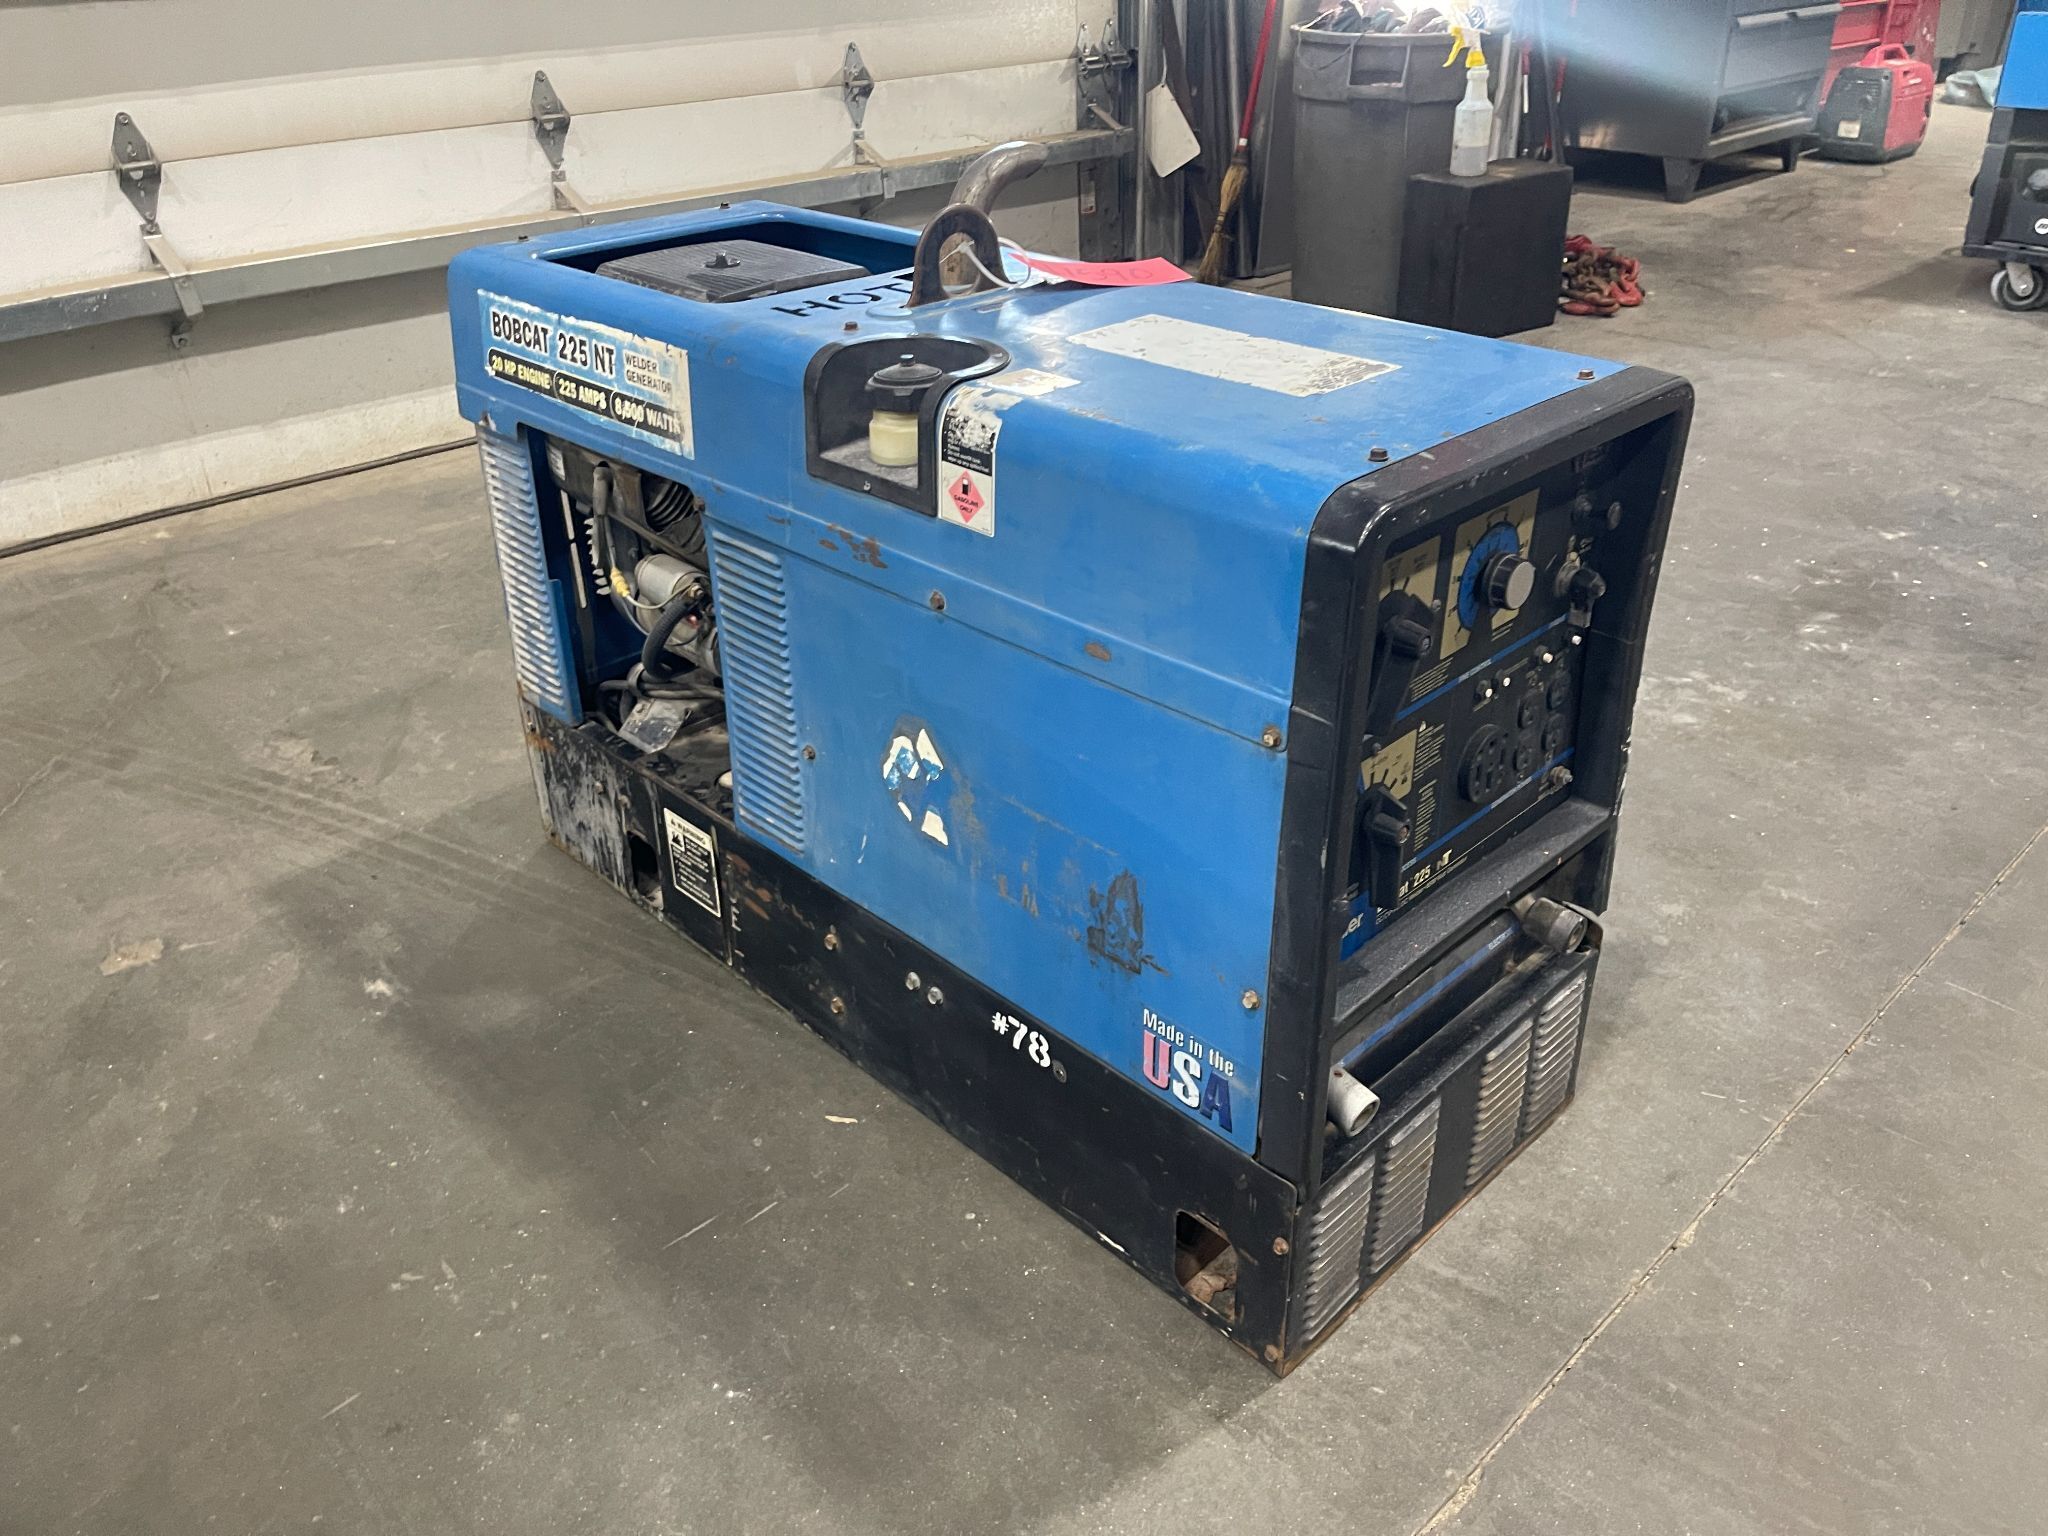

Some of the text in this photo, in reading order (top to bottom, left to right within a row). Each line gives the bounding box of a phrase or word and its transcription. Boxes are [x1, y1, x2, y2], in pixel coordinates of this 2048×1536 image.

[492, 311, 615, 376] BOBCAT 225 NT
[492, 355, 551, 389] 20 HP ENGINE
[625, 351, 658, 374] WELDER
[558, 378, 607, 410] 225 AMPS
[626, 369, 672, 393] GENERATOR
[1412, 864, 1432, 887] 225
[991, 1011, 1051, 1068] #78
[1143, 1008, 1235, 1077] Made in the
[1143, 1029, 1233, 1134] USA
